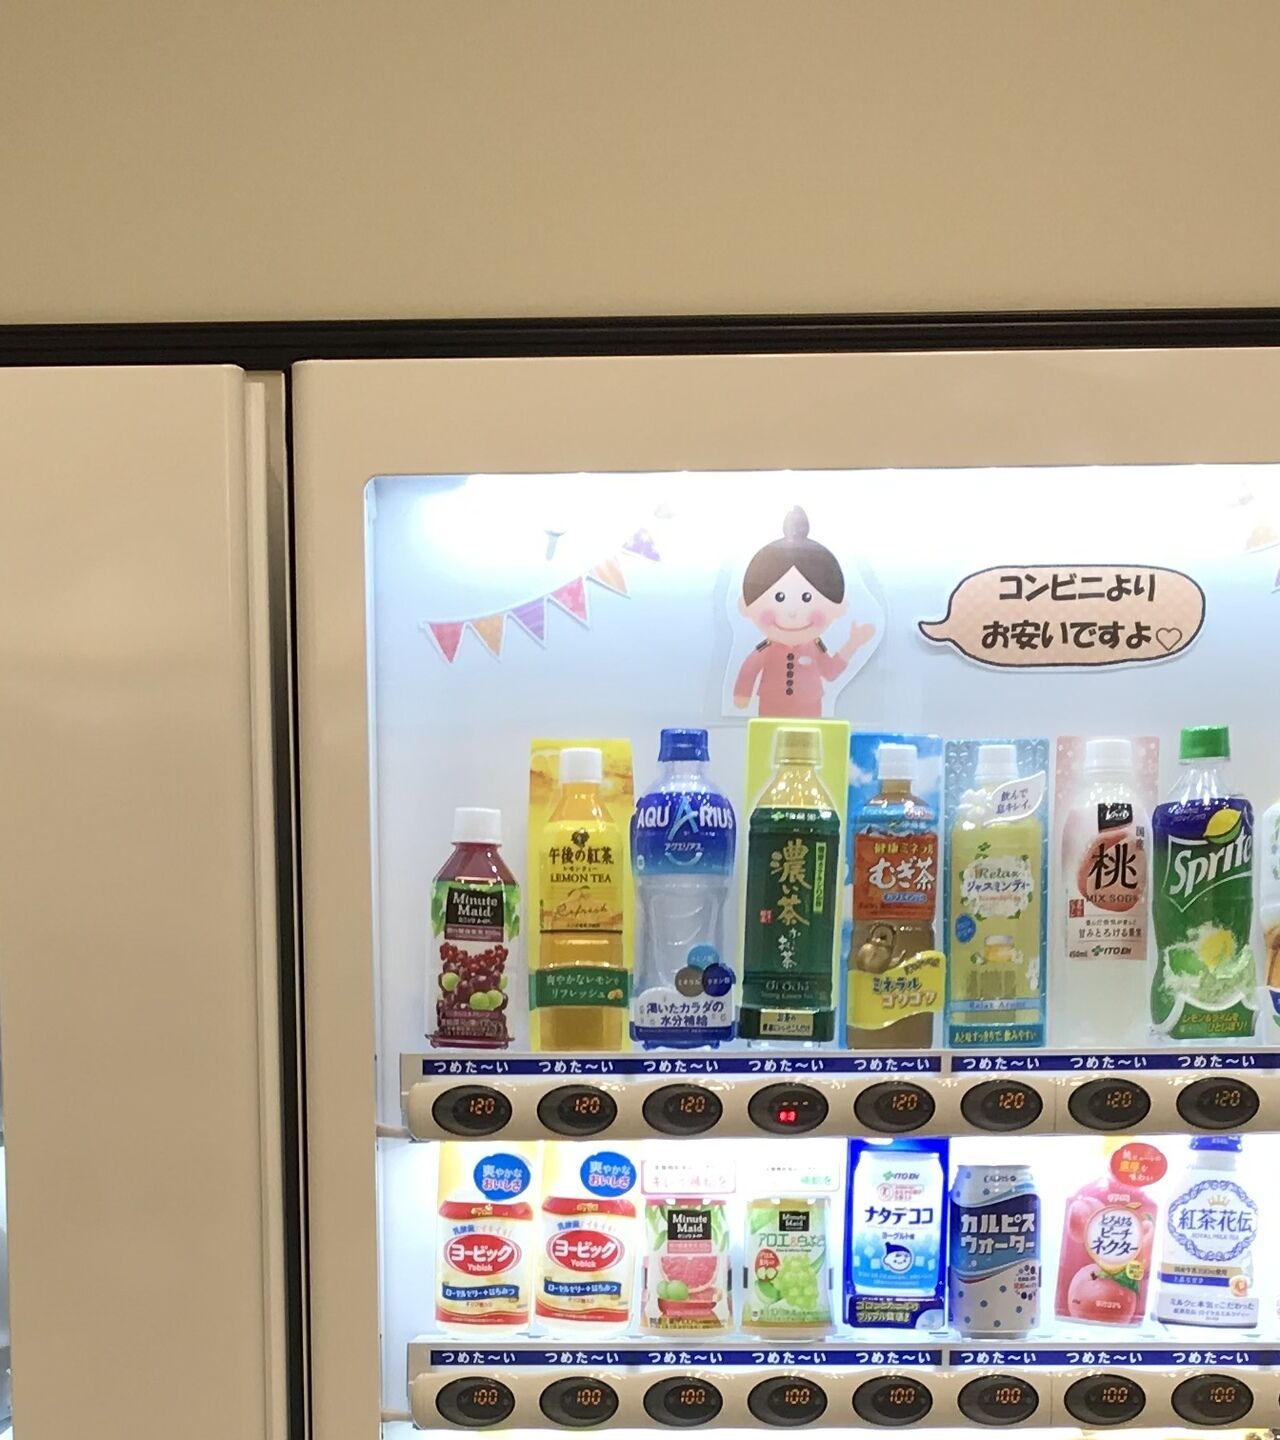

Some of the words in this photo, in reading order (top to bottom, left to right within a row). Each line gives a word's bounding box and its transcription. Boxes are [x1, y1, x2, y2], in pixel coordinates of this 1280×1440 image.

[998, 573, 1157, 601] コンビニより
[636, 796, 733, 841] AQUARIUS
[548, 847, 614, 865] 午後の紅茶
[868, 857, 936, 890] むぎ茶
[1088, 842, 1138, 890] 桃
[1169, 834, 1252, 899] Sprite
[550, 873, 588, 883] LEMON
[590, 873, 612, 883] TEA
[771, 838, 812, 927] 濃い茶
[452, 892, 499, 906] Minute
[457, 904, 492, 917] Maid
[660, 1014, 708, 1027] 水分補給
[469, 1097, 496, 1114] 120
[679, 1096, 706, 1113] 120
[1213, 1090, 1241, 1107] 120
[672, 1214, 708, 1224] Minute
[864, 1206, 934, 1225] ナタデココ
[960, 1212, 1036, 1234] カルピス
[1101, 1214, 1133, 1226] とろける
[1178, 1207, 1253, 1233] 紅茶花伝
[677, 1223, 703, 1233] Maid
[1101, 1227, 1133, 1239] ピーチ
[450, 1243, 514, 1262] ヨービック
[554, 1240, 618, 1259] ヨービック
[960, 1234, 1036, 1255] ウォーター
[1091, 1239, 1138, 1256] ネクター
[472, 1388, 498, 1405] 100
[889, 1388, 916, 1405] 100
